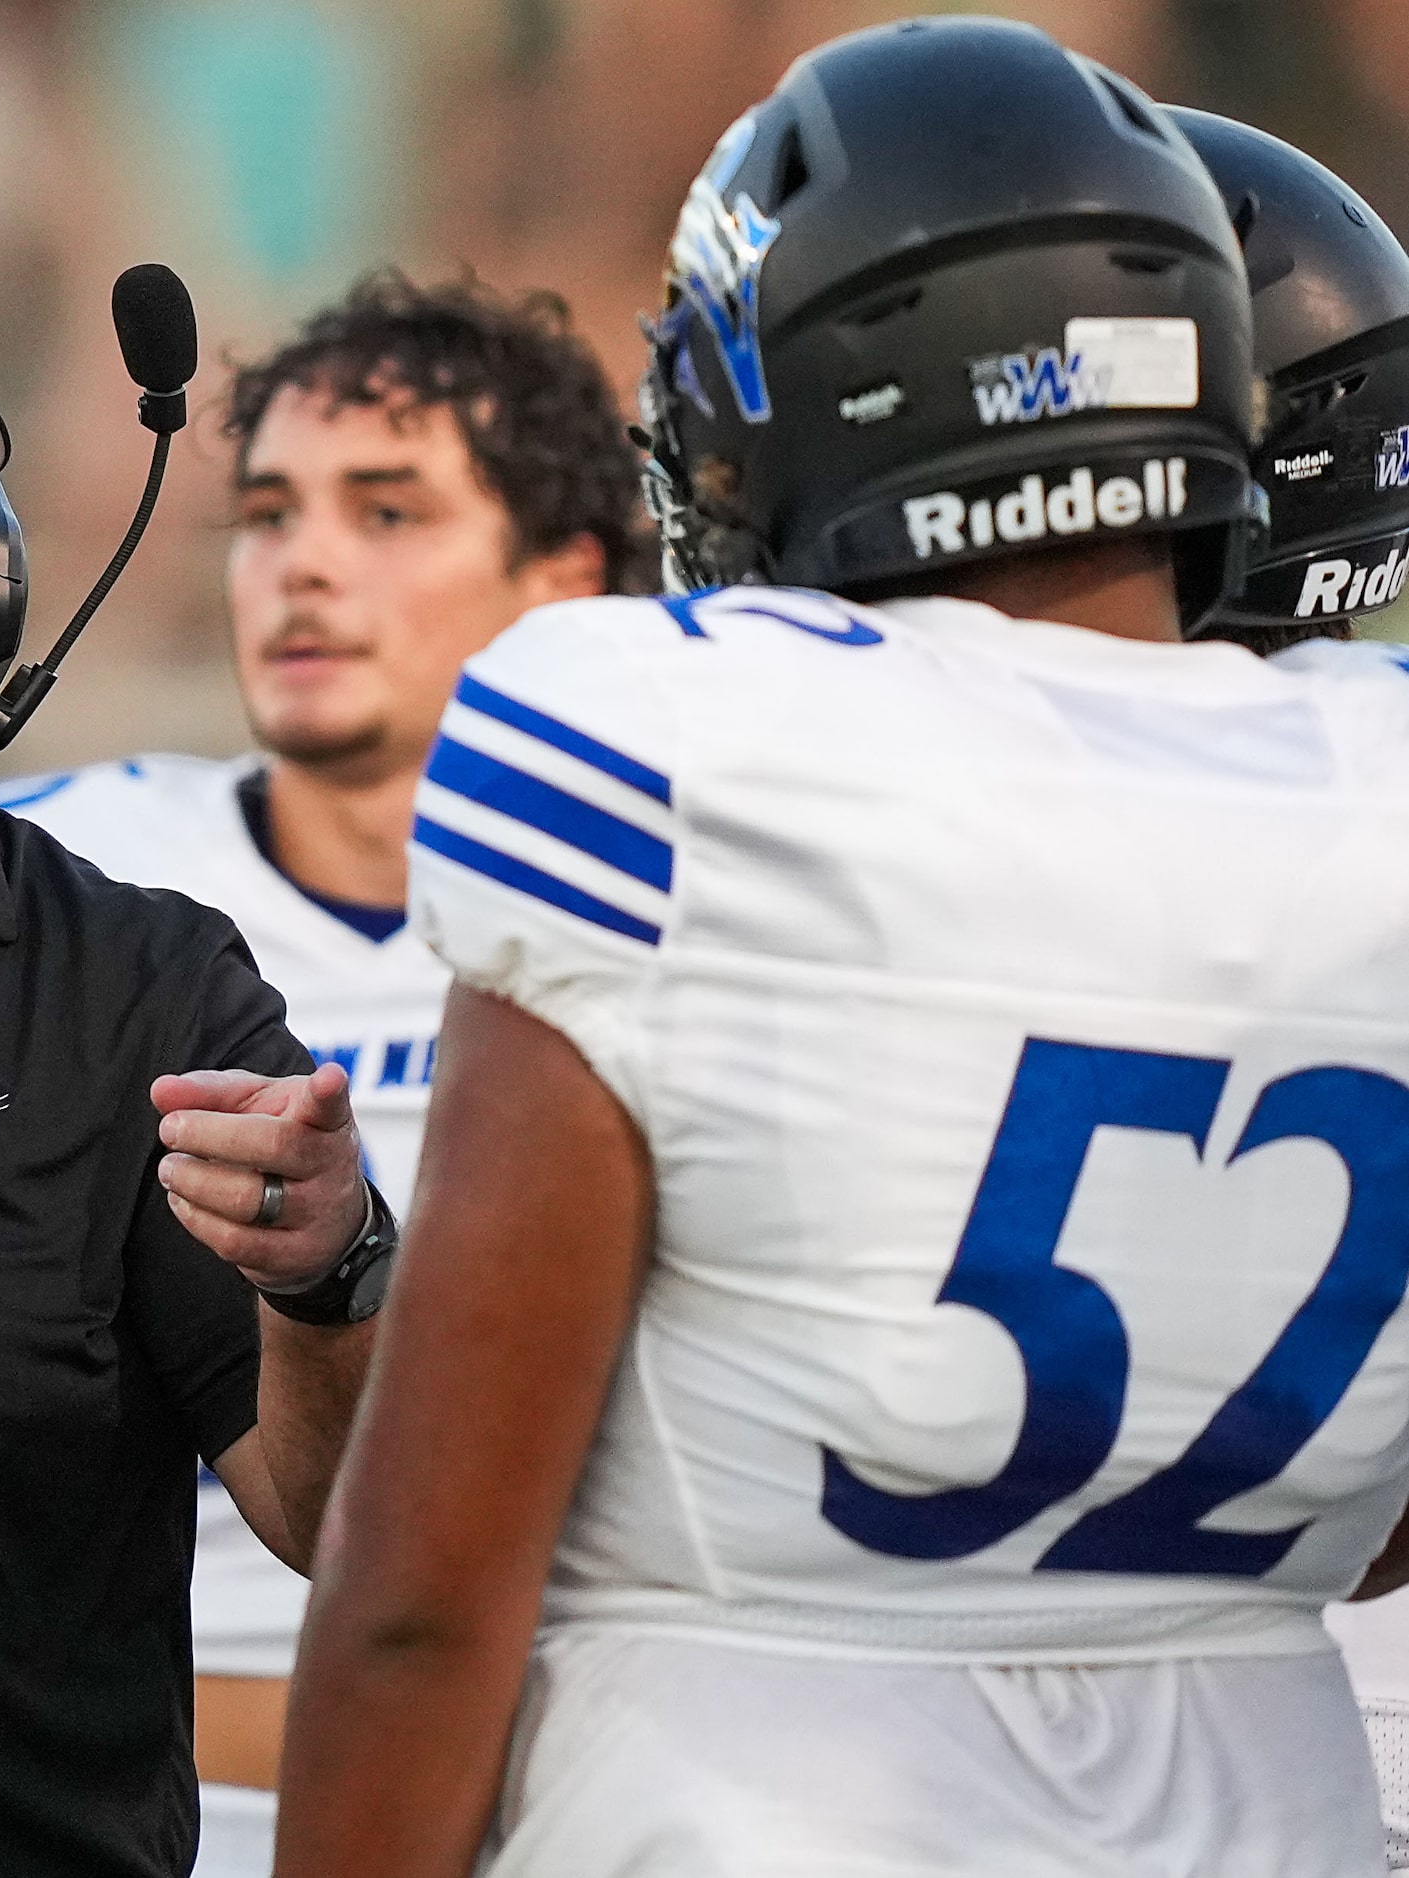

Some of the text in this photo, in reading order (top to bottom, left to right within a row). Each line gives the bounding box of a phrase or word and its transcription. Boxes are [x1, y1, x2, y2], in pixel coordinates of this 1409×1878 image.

[902, 456, 1188, 559] Riddell
[1274, 449, 1329, 475] Riddell
[818, 1036, 1409, 1580] 52
